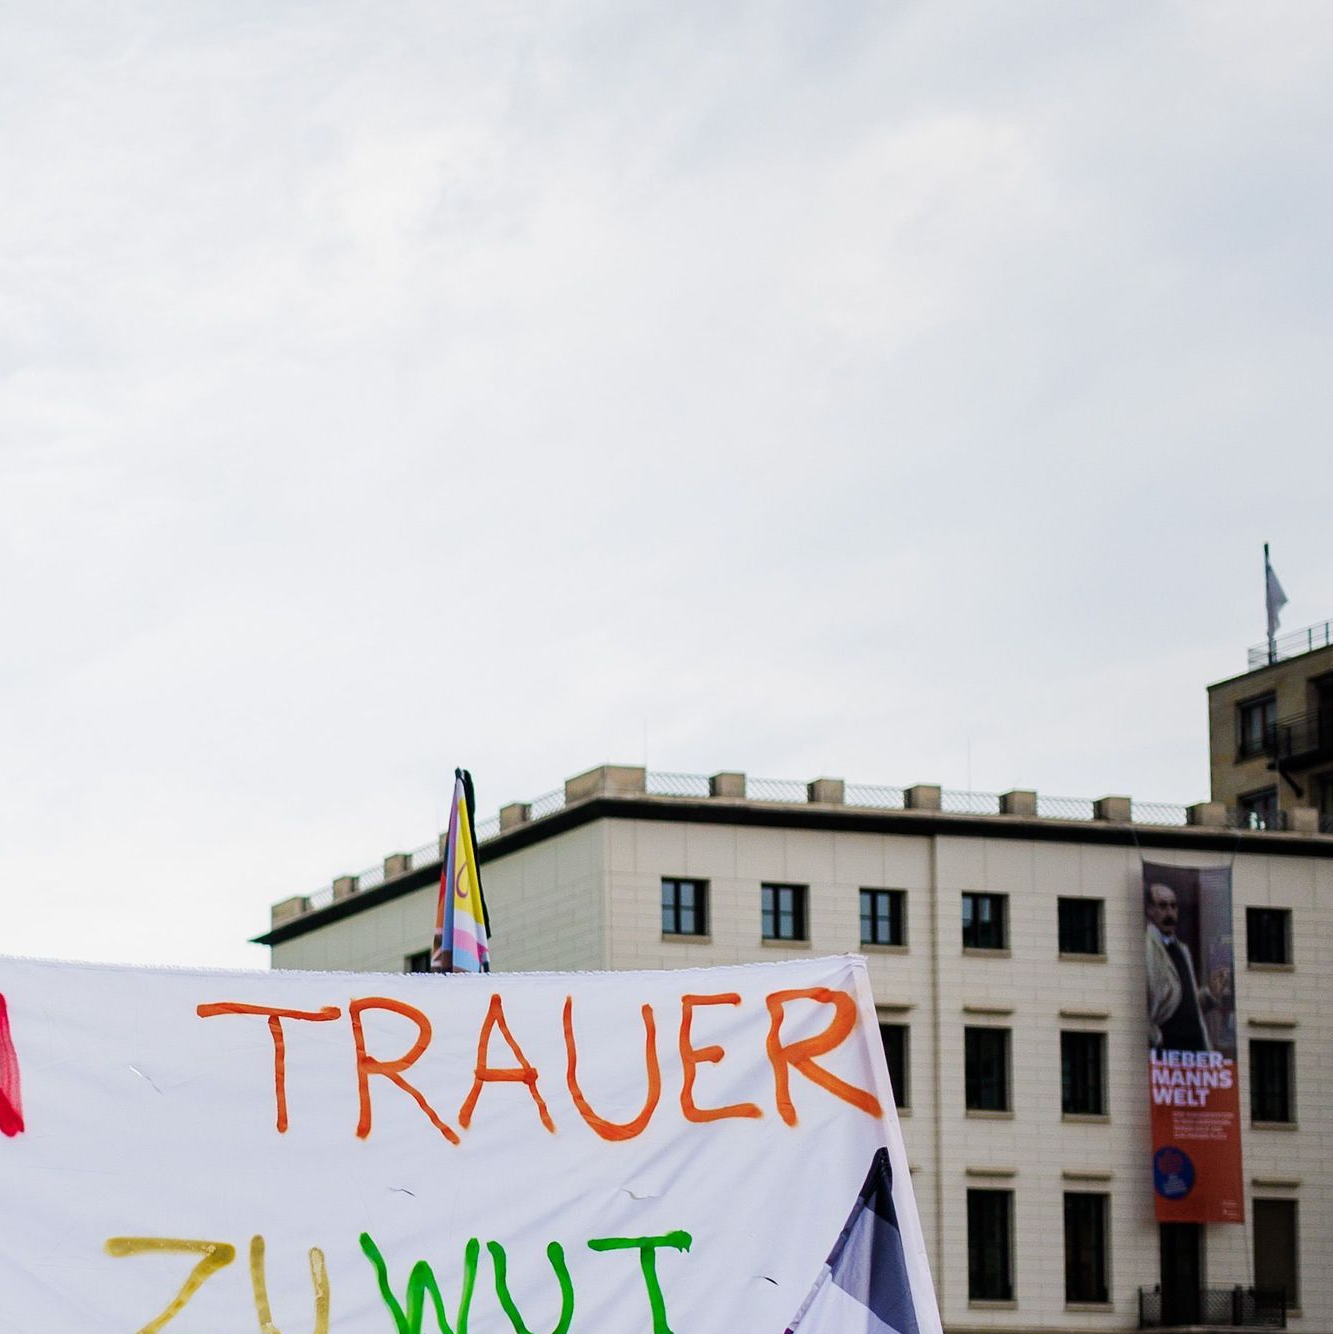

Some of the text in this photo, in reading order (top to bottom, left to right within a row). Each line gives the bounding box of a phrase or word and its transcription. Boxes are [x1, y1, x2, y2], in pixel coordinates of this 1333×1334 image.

[197, 987, 884, 1146] TRAUER
[1151, 1048, 1233, 1068] LIEBER-
[1152, 1069, 1233, 1088] MANNS
[1153, 1086, 1210, 1107] WELT
